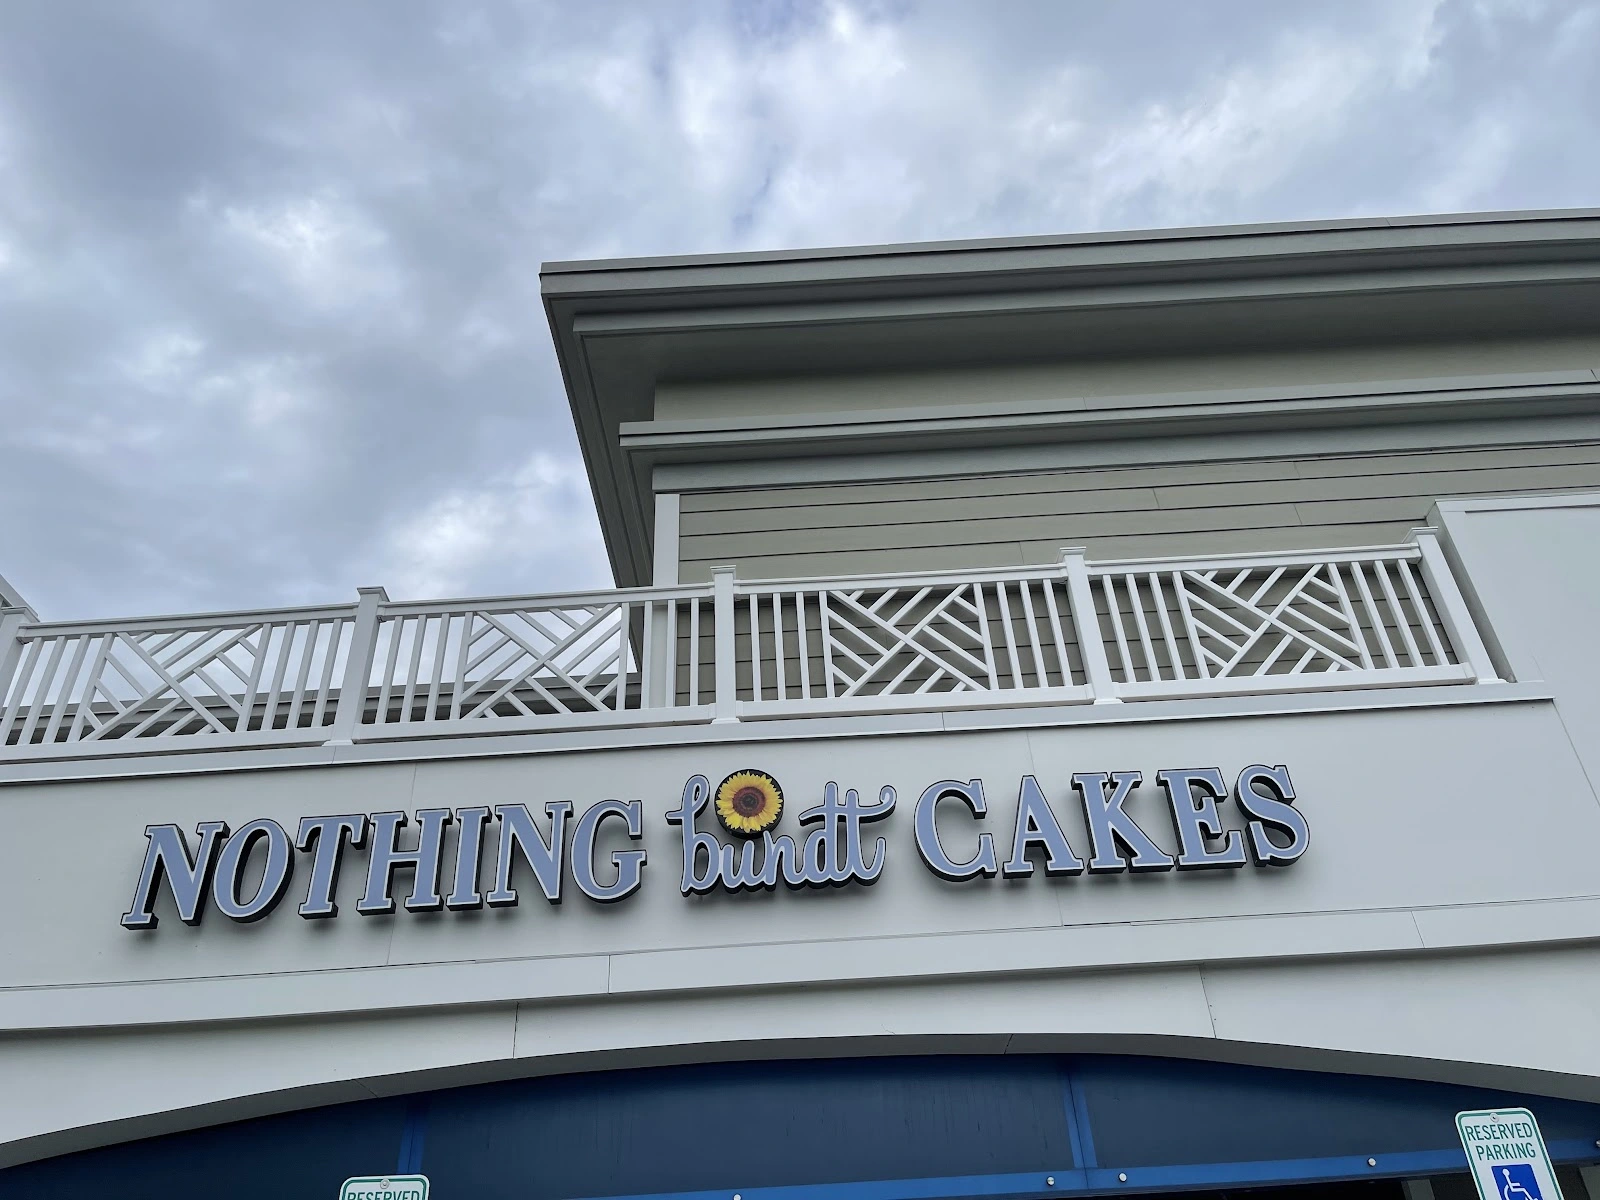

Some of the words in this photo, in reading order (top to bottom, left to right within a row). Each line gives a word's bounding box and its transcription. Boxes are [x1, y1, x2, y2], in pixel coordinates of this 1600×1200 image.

[120, 799, 647, 930] NOTHING
[666, 774, 897, 897] bundt
[913, 764, 1310, 882] CAKES
[1465, 1122, 1533, 1141] RESERVED
[1475, 1142, 1536, 1161] PARKING
